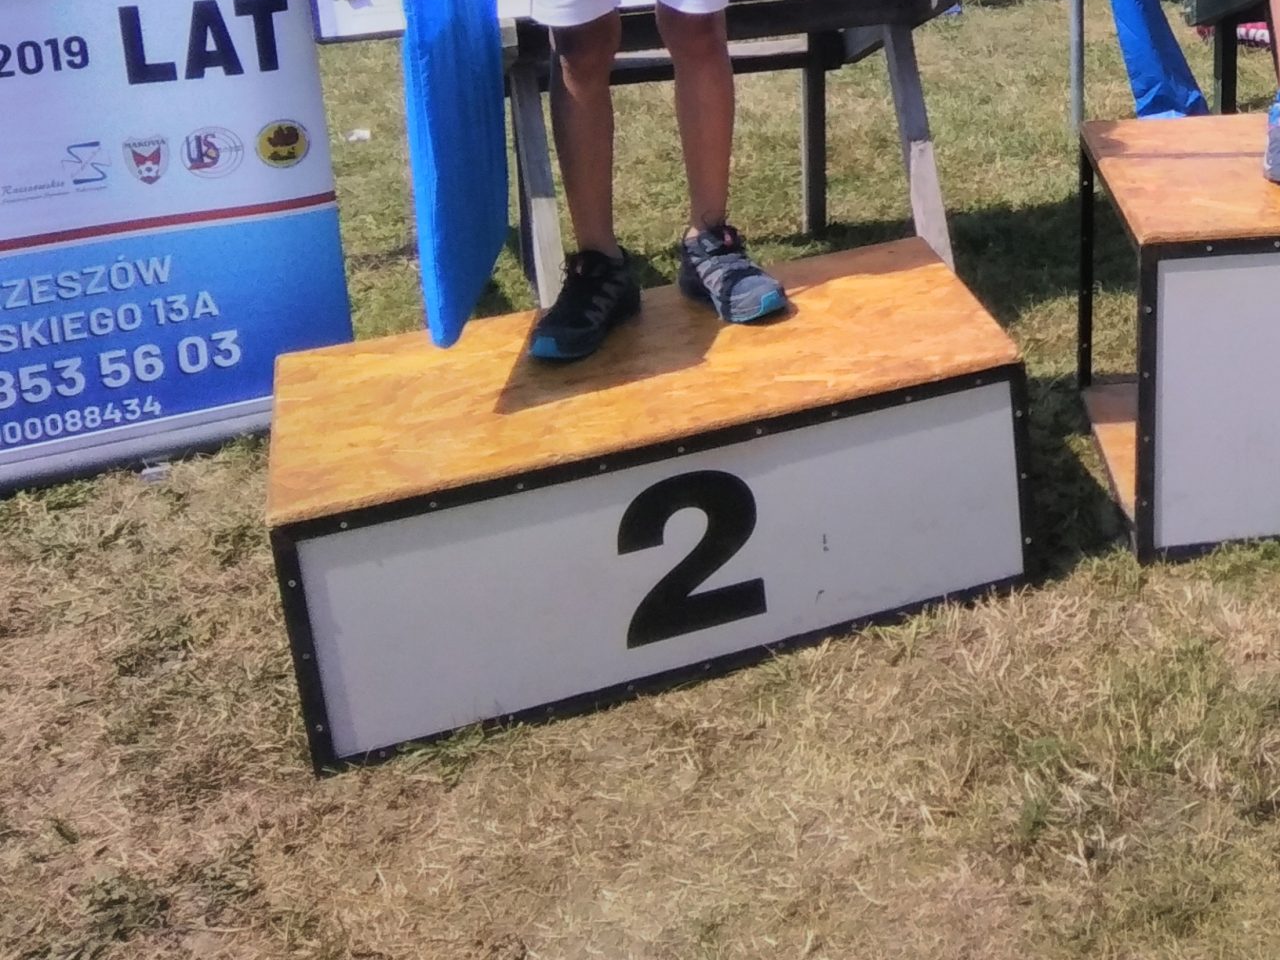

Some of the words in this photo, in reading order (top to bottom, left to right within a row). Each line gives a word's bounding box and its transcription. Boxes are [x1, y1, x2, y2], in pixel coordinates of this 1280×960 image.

[0, 35, 90, 78] 2019
[0, 255, 172, 310] ZESZÓW
[150, 290, 219, 326] 13A
[100, 344, 165, 388] 56
[177, 330, 242, 374] 03
[617, 469, 767, 650] 2
